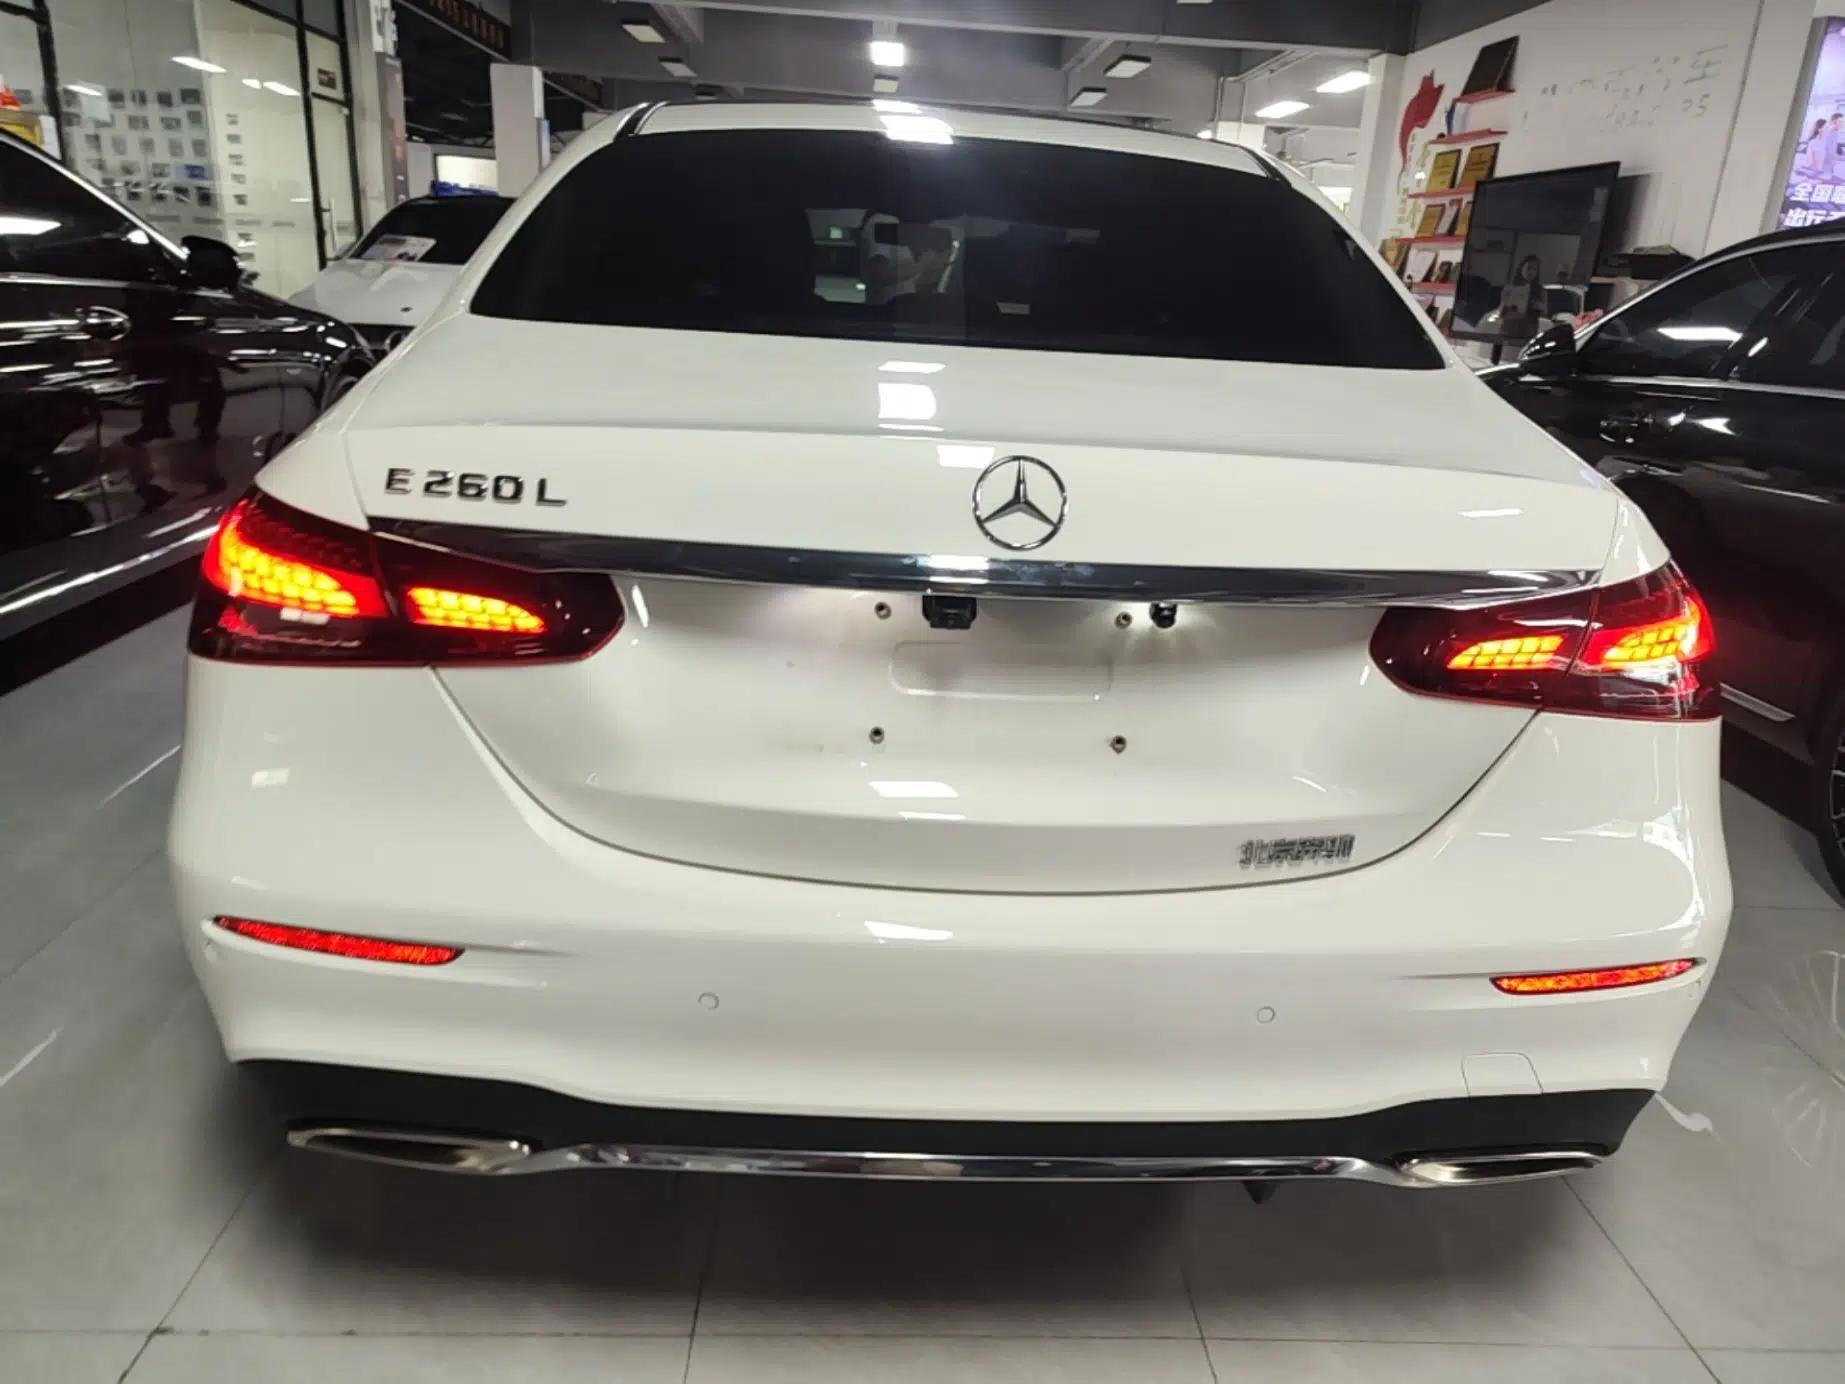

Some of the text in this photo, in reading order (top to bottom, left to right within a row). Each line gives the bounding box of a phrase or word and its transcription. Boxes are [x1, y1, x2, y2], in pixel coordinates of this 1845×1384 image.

[384, 467, 568, 507] E 260 L
